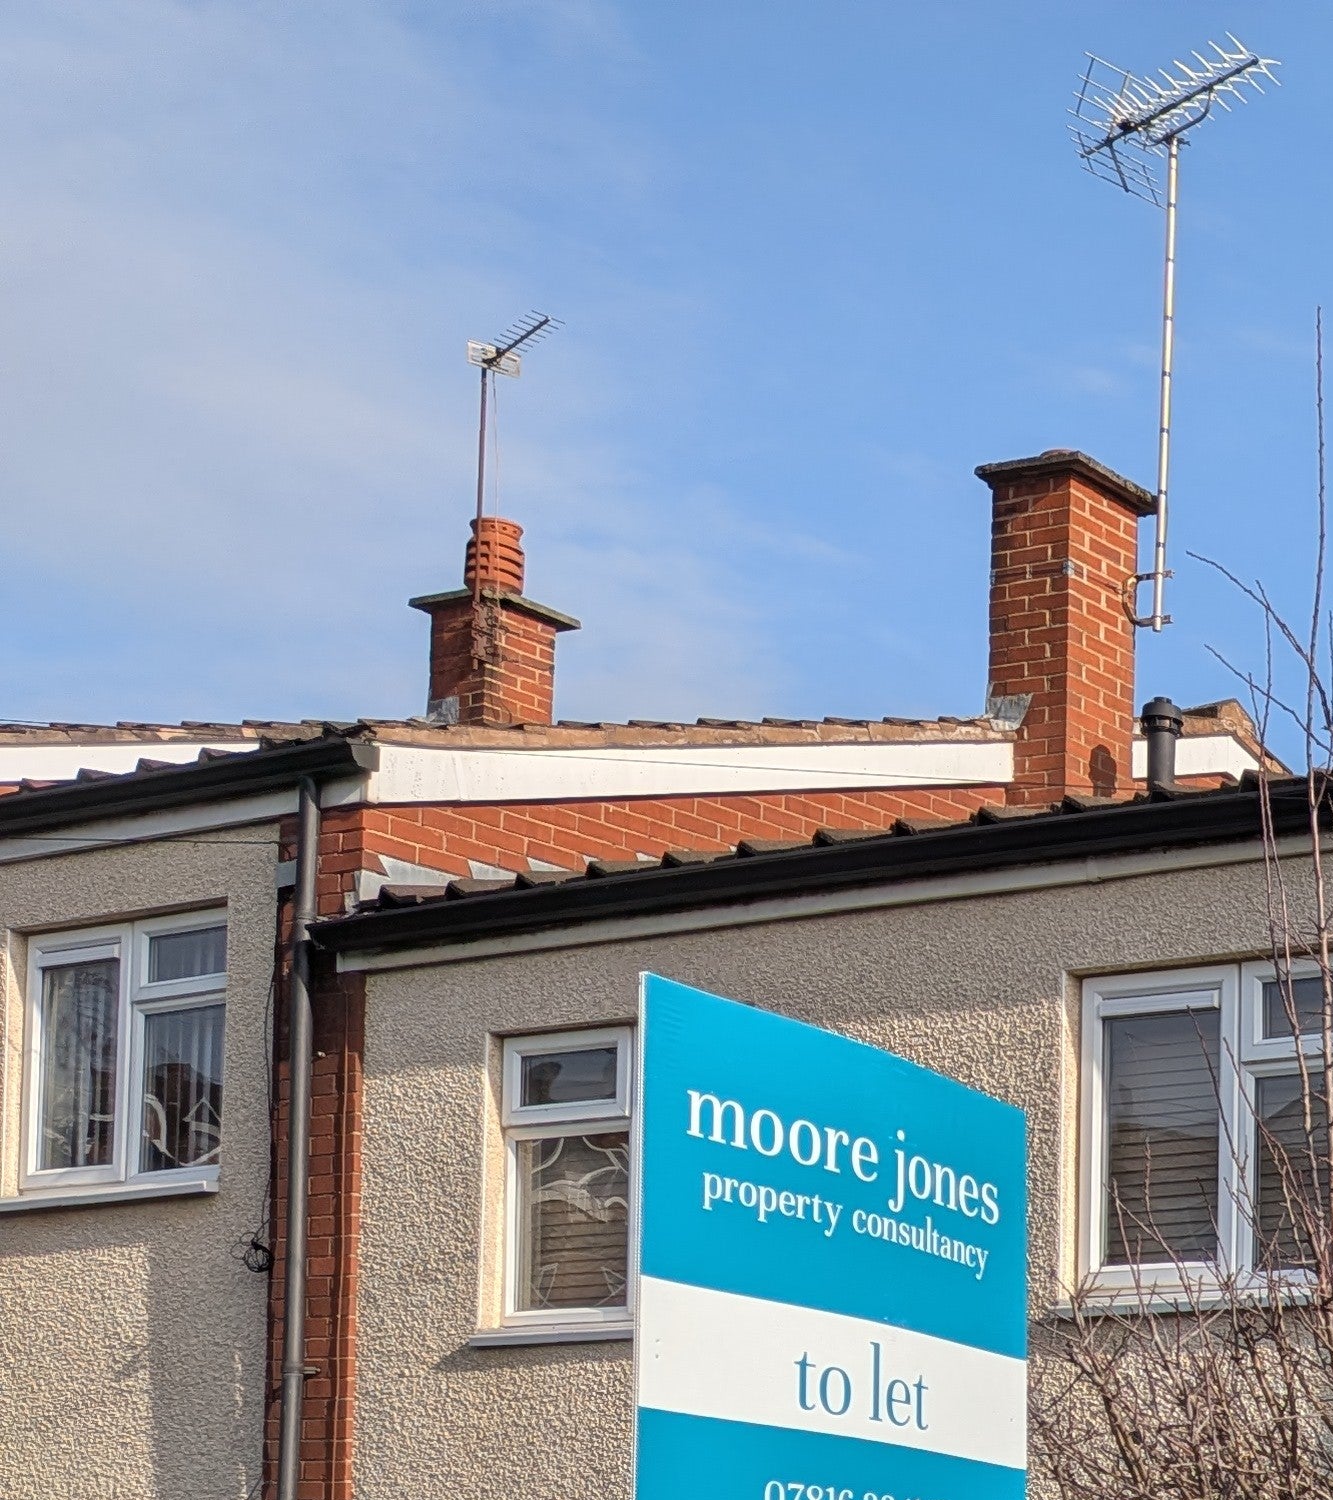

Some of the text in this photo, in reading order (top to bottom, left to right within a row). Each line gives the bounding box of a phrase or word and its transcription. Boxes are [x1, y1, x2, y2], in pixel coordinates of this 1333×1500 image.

[687, 1090, 1000, 1225] moore jones
[703, 1172, 989, 1280] property consultancy
[794, 1341, 929, 1431] to let
